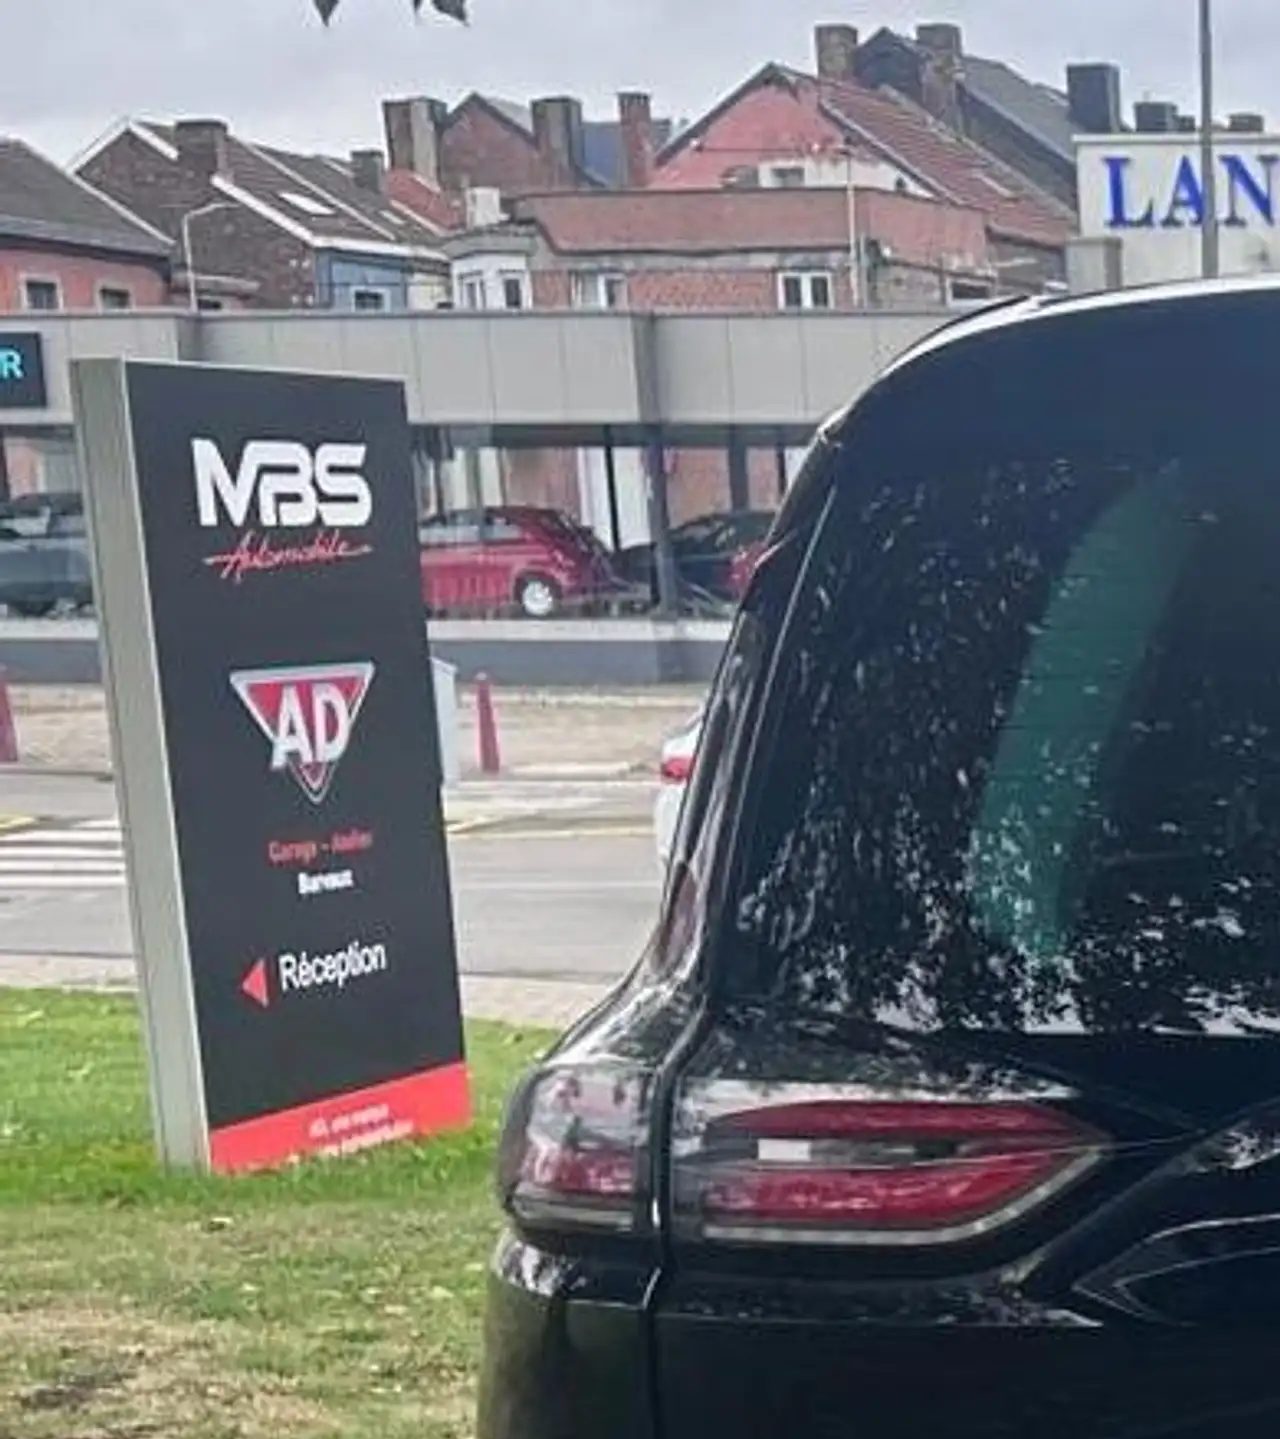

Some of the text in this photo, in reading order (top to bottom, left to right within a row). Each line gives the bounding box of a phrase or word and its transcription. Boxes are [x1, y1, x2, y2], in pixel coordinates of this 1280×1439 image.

[191, 438, 372, 527] MBS
[271, 683, 350, 769] AD
[278, 940, 386, 991] Réception
